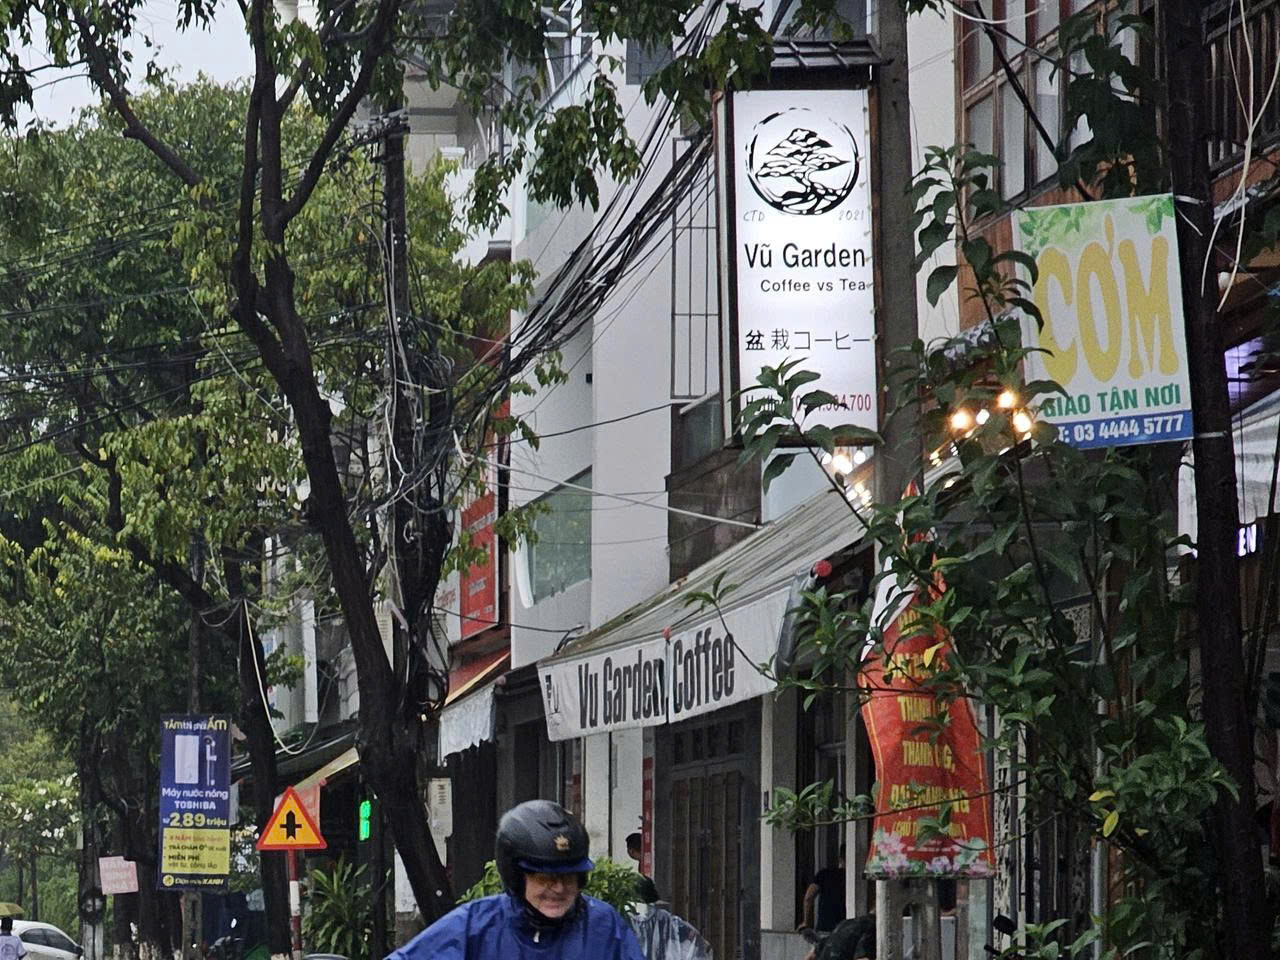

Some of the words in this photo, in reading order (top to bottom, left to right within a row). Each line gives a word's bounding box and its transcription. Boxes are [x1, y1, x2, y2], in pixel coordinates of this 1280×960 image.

[743, 209, 765, 222] CTD
[838, 209, 865, 221] 2021
[745, 243, 772, 268] Vũ
[783, 242, 866, 268] Garden
[760, 278, 811, 292] Coffee
[817, 280, 834, 292] vs
[840, 278, 866, 291] Tea
[1034, 214, 1179, 386] CƠM
[745, 327, 871, 351] 盆栽コーヒー
[1043, 393, 1091, 417] GIAO
[1097, 386, 1138, 415] TẬN
[1145, 382, 1181, 408] NƠI
[1073, 423, 1095, 442] 03
[1099, 419, 1140, 439] 4444
[1144, 414, 1184, 435] 5777
[578, 662, 599, 729] Vu
[602, 649, 666, 725] Garden
[672, 626, 735, 714] Coffee
[162, 787, 183, 799] Máy
[205, 788, 228, 800] nóng
[174, 801, 216, 810] TOSHIBA
